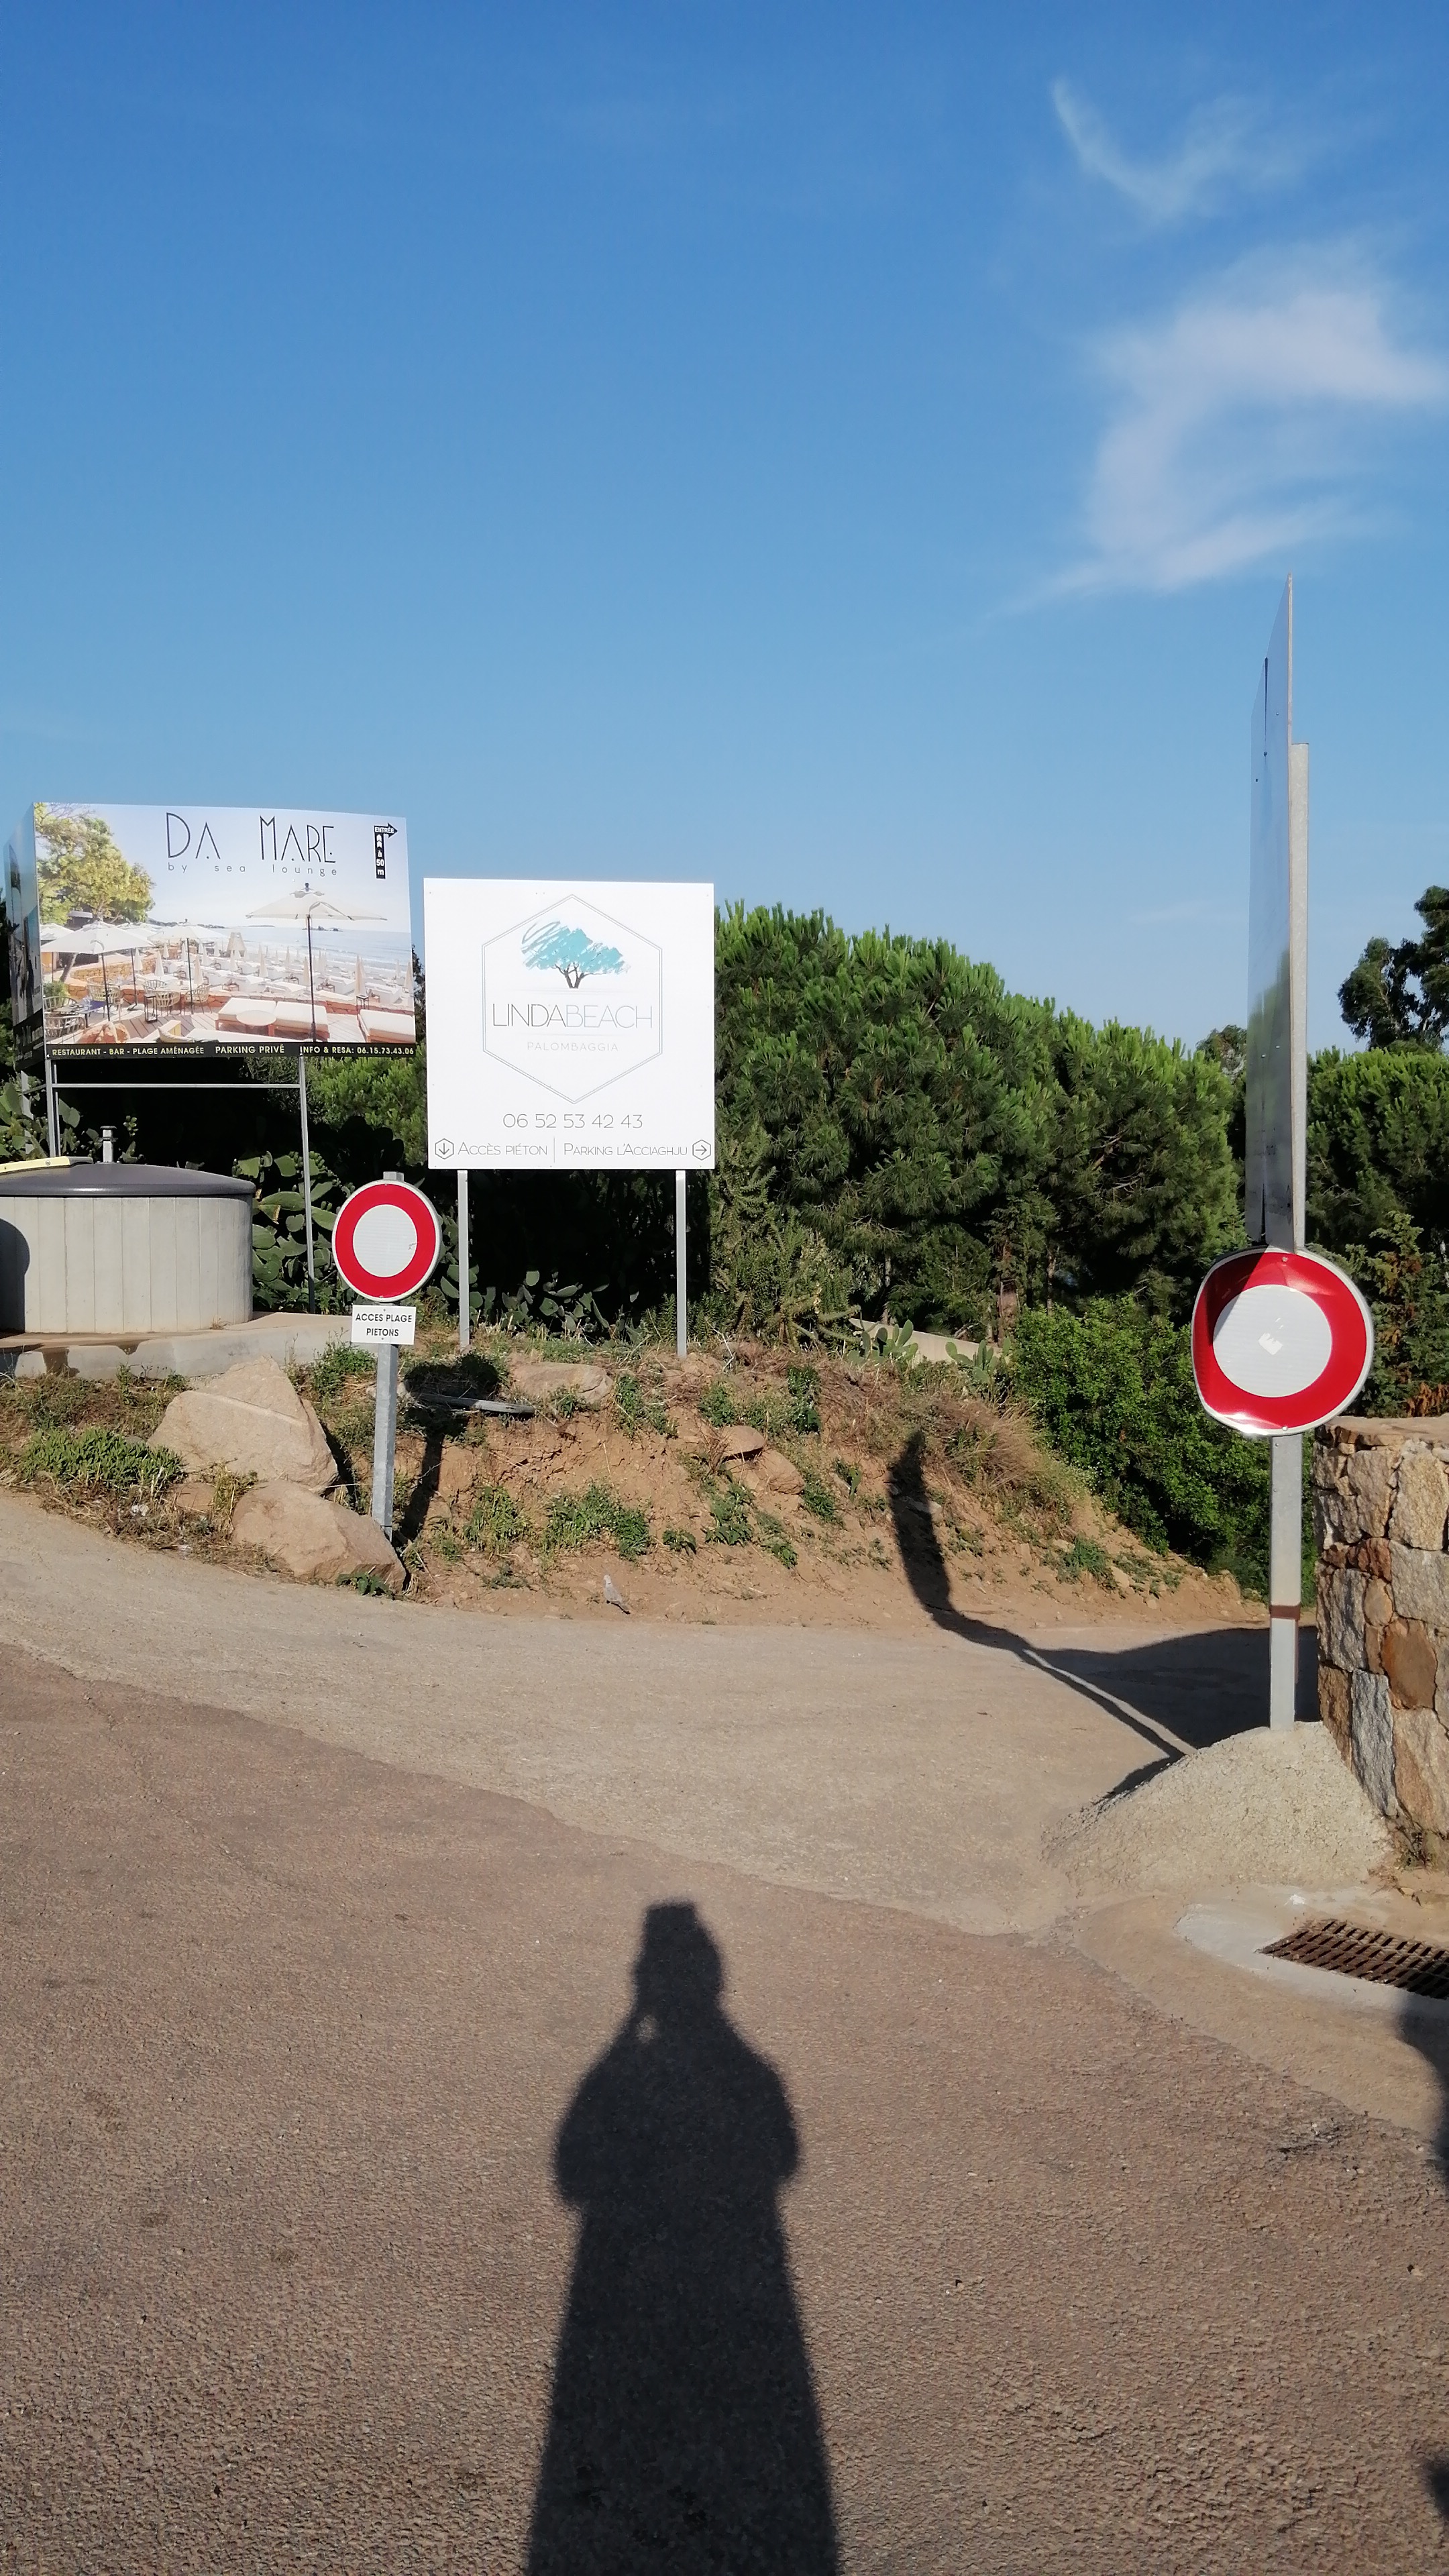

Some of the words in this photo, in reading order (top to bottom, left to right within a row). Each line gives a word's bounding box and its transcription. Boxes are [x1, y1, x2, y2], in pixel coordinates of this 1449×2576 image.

[166, 812, 221, 859] DA
[376, 859, 384, 867] 50
[168, 862, 187, 873] by
[272, 864, 337, 877] lounge
[160, 1046, 204, 1055] AMÉNAGÉE
[215, 1046, 256, 1054] PARKING
[259, 1044, 284, 1054] PRIVÉ
[300, 1046, 321, 1054] INFO
[357, 1046, 415, 1055] 06.15.73.43.06
[527, 1041, 619, 1052] PALOMBAGGIA
[502, 1114, 528, 1128] 06
[535, 1114, 557, 1128] 52
[564, 1114, 585, 1128] 53
[592, 1114, 614, 1128] 42
[621, 1114, 643, 1128] 43
[356, 1313, 383, 1322] ACCES
[386, 1314, 413, 1323] PLAGE
[366, 1328, 399, 1336] PIETONS
